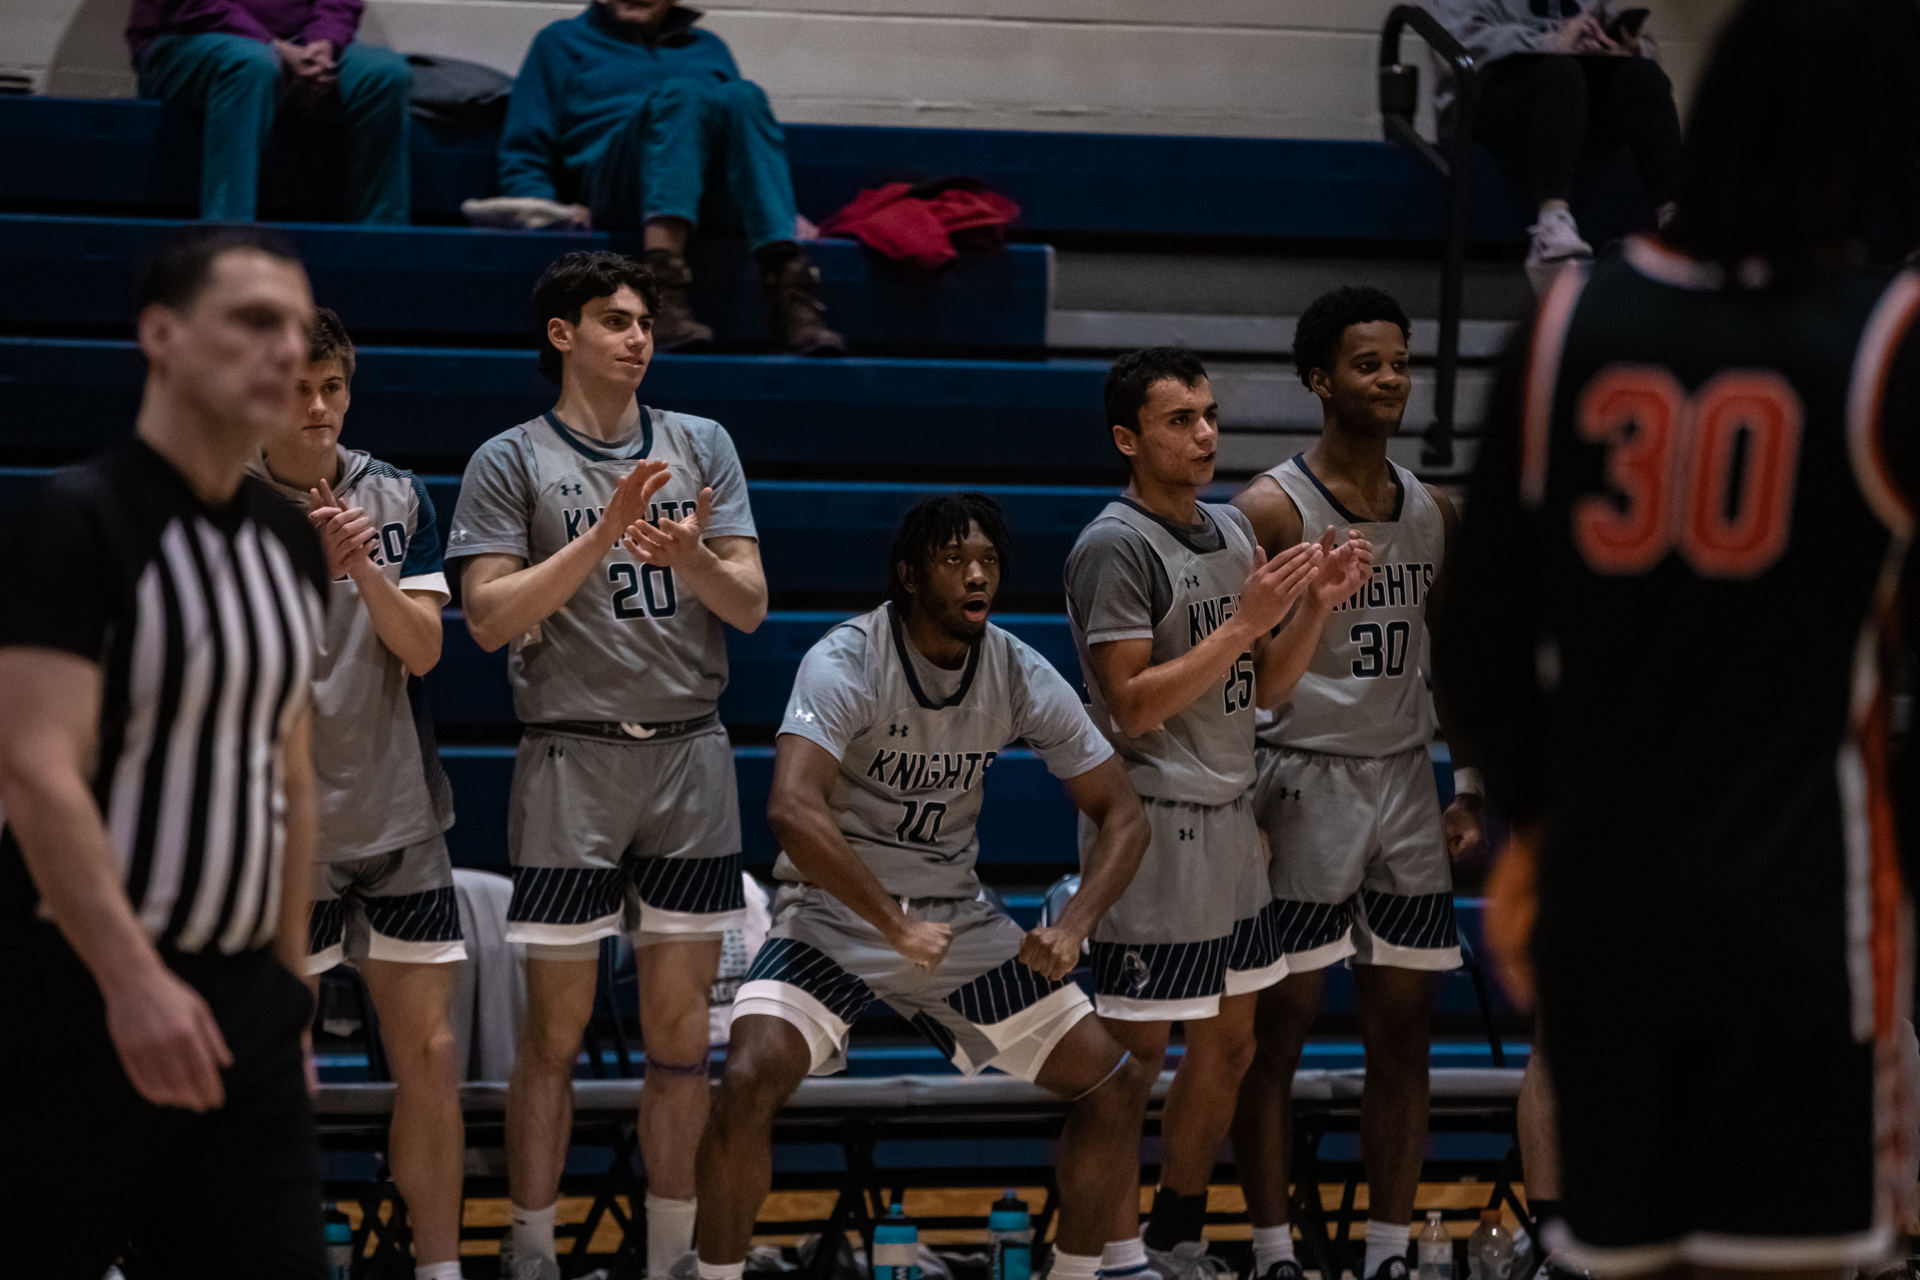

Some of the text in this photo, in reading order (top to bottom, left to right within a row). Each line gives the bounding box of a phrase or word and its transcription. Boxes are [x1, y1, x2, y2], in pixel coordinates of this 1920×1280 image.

[1573, 362, 1804, 580] 30
[608, 562, 677, 621] 20
[1350, 620, 1410, 680] 30
[1224, 650, 1256, 716] 25
[896, 800, 947, 843] 10
